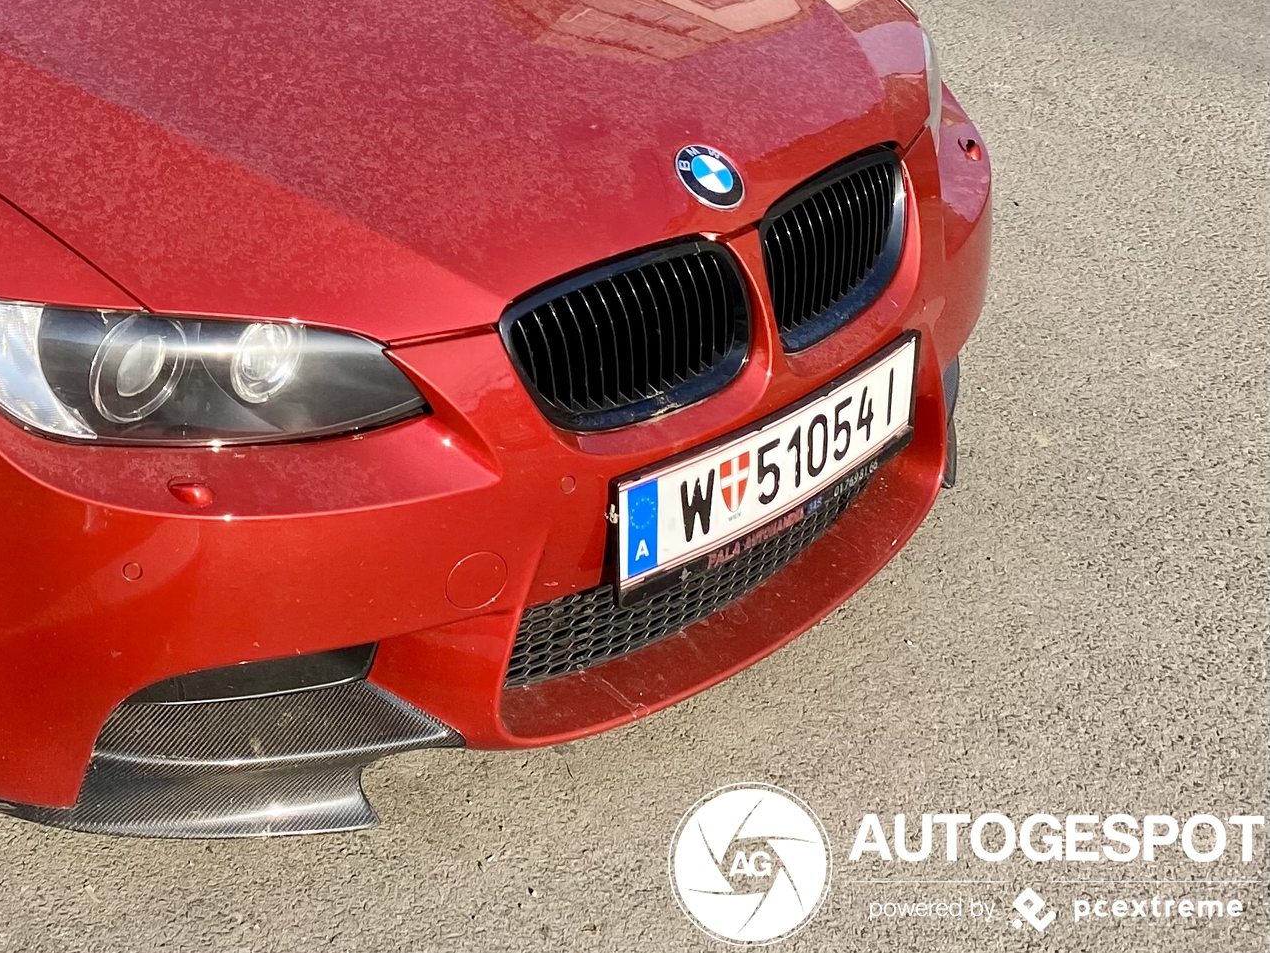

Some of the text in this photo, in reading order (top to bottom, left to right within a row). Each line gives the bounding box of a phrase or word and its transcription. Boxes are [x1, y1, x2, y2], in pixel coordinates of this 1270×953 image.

[678, 146, 720, 172] BMW
[635, 539, 650, 562] A
[681, 469, 715, 543] W
[757, 385, 874, 506] 51054
